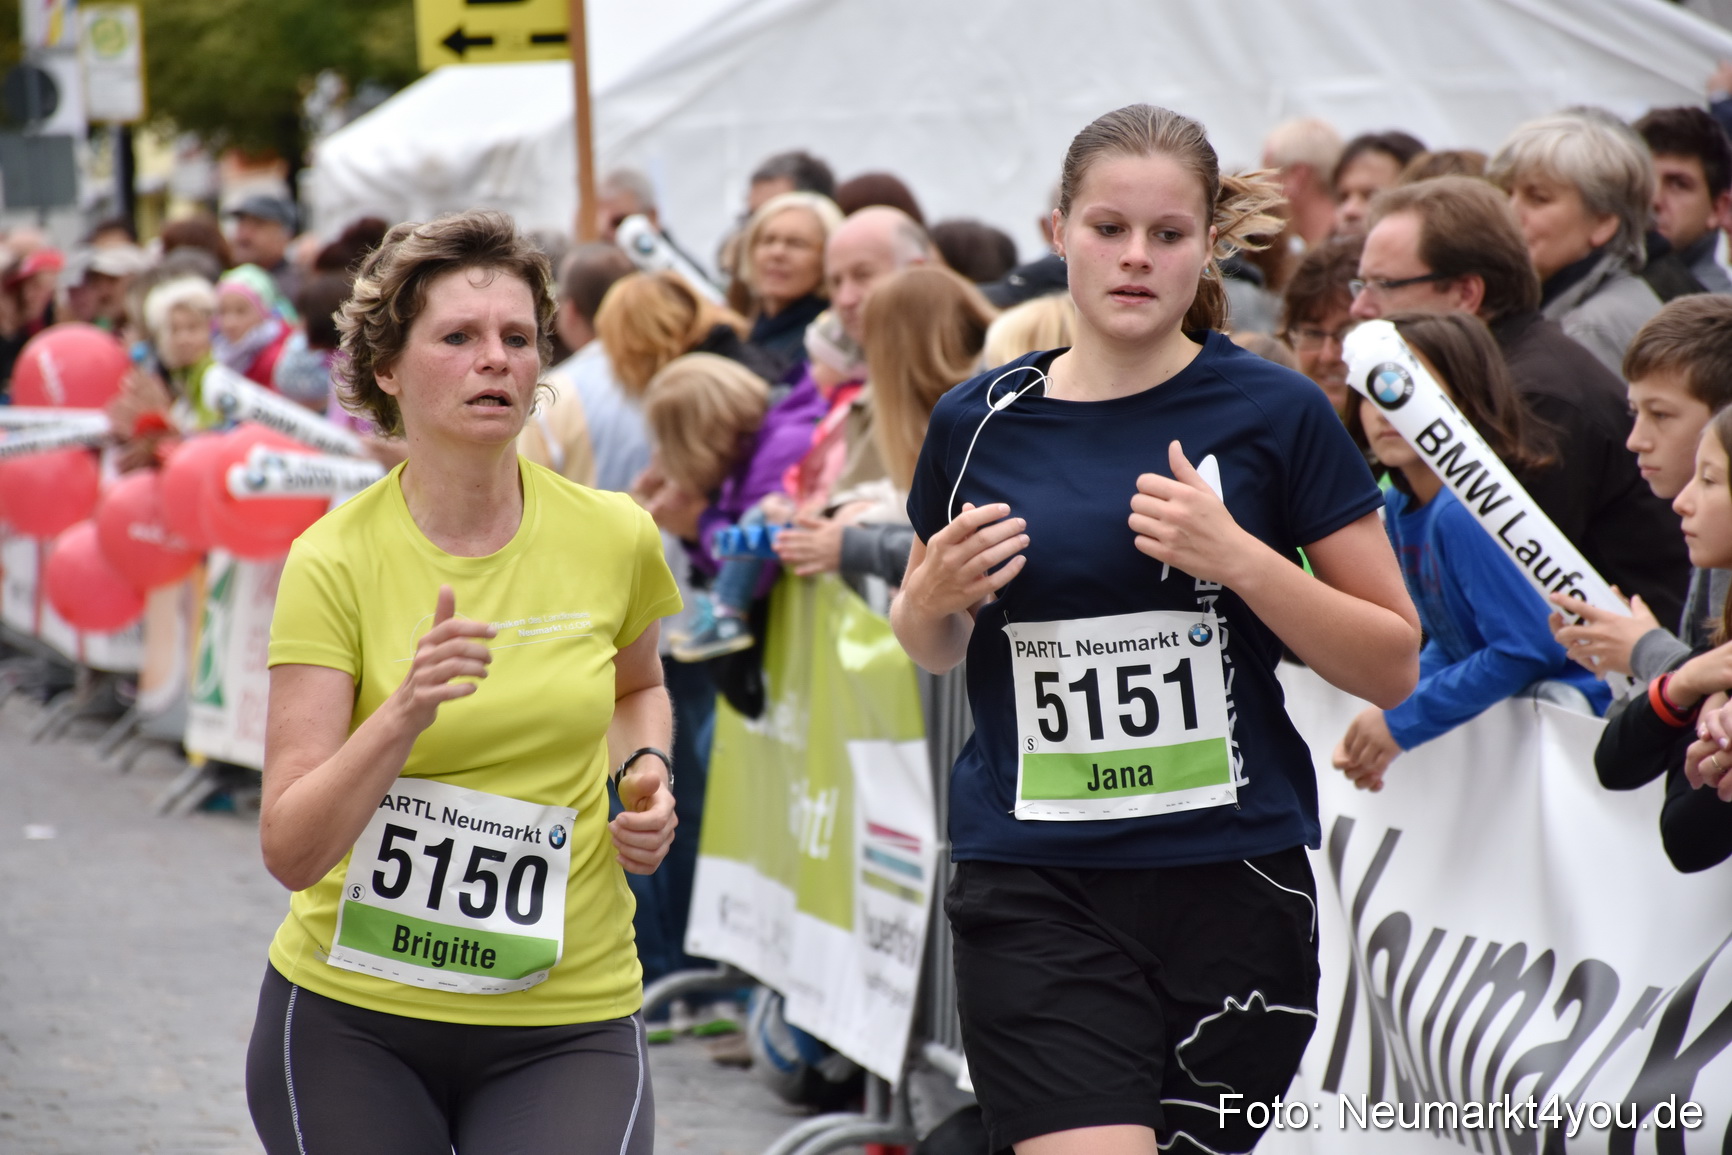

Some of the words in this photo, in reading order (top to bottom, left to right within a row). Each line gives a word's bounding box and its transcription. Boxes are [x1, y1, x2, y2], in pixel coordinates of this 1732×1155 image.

[1415, 417, 1513, 518] BMW
[518, 624, 562, 637] Neumarkt
[1015, 640, 1071, 659] PARTL
[1075, 631, 1180, 657] Neumarkt
[1034, 657, 1199, 743] 5151
[1027, 738, 1035, 751] S
[1087, 763, 1154, 792] Jana
[378, 794, 437, 821] ARTL
[442, 806, 542, 844] Neumarkt
[352, 885, 361, 899] S
[371, 823, 549, 926] 5150
[392, 924, 497, 969] Brigitte
[1322, 815, 1732, 1155] Neumark
